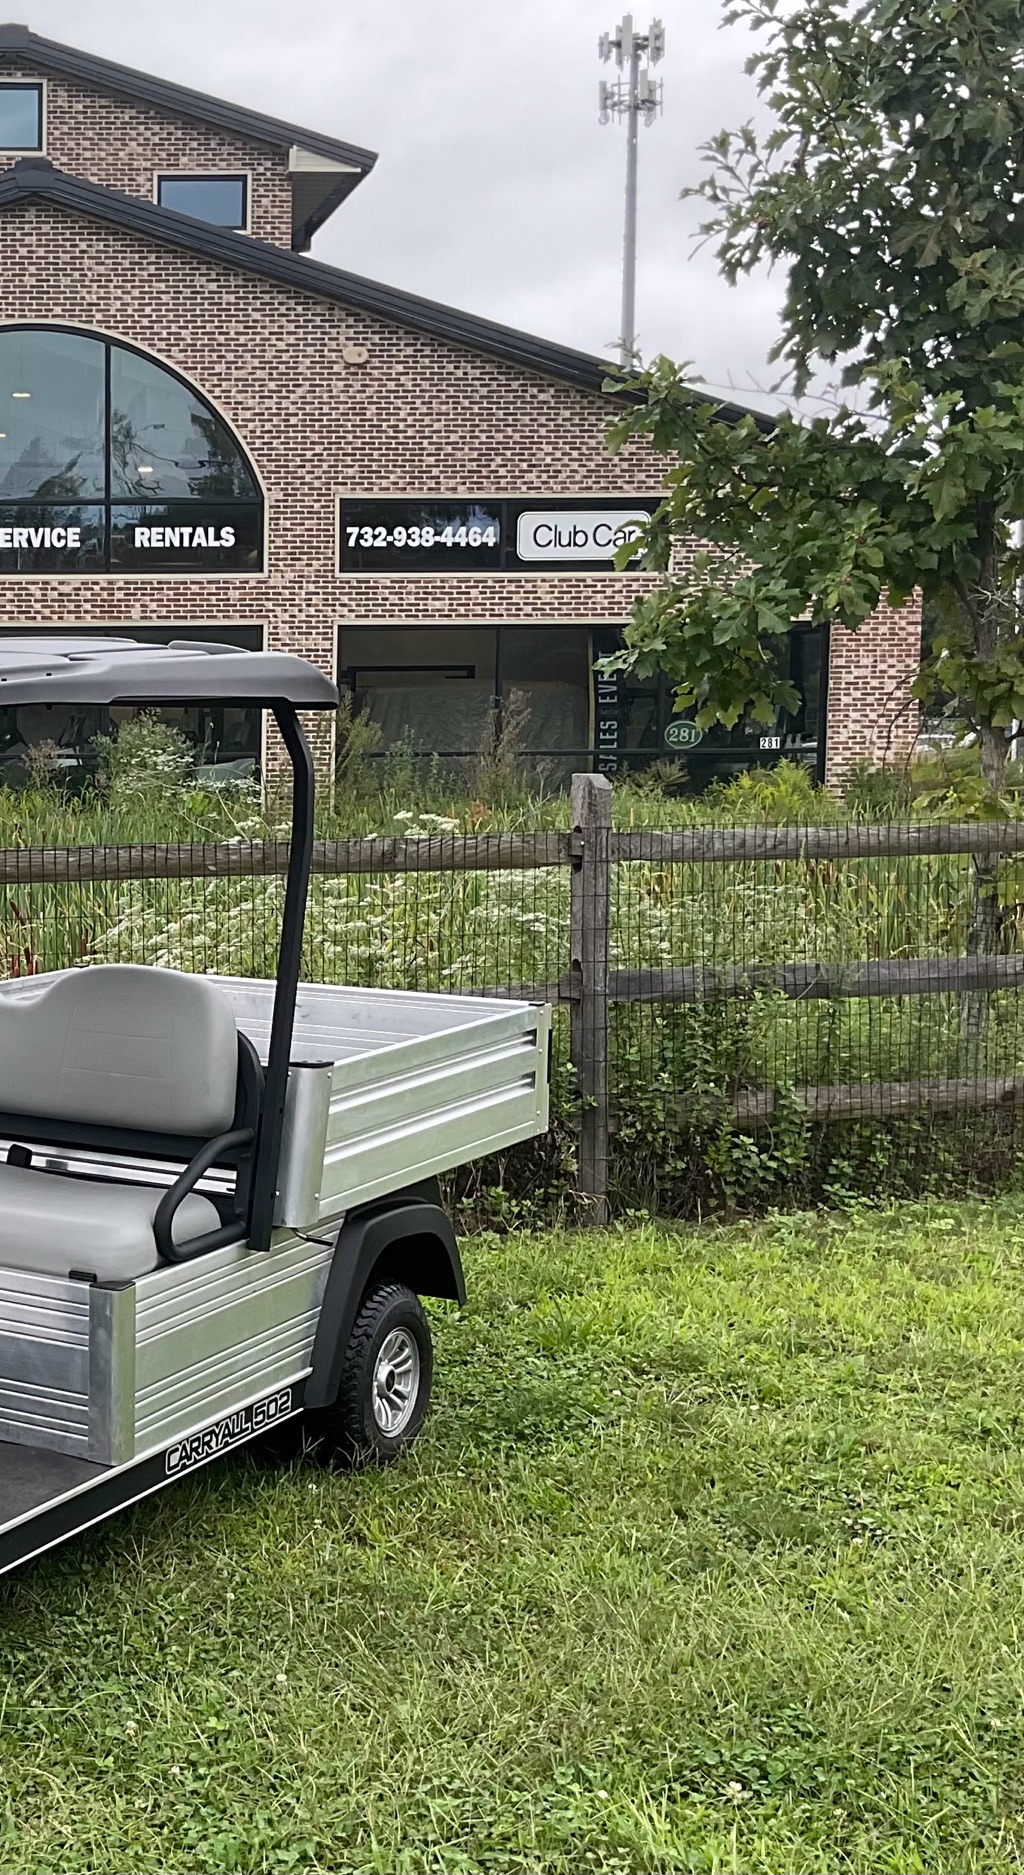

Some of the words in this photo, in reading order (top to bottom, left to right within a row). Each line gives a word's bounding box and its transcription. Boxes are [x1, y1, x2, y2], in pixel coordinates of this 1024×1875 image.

[134, 526, 235, 548] RENTALS
[346, 526, 496, 547] 732-938-4464
[533, 523, 589, 548] Club
[597, 651, 618, 703] EVET
[668, 727, 696, 743] 281
[761, 738, 779, 749] 281
[165, 1410, 252, 1475] CARRYALL
[252, 1387, 292, 1429] 502
